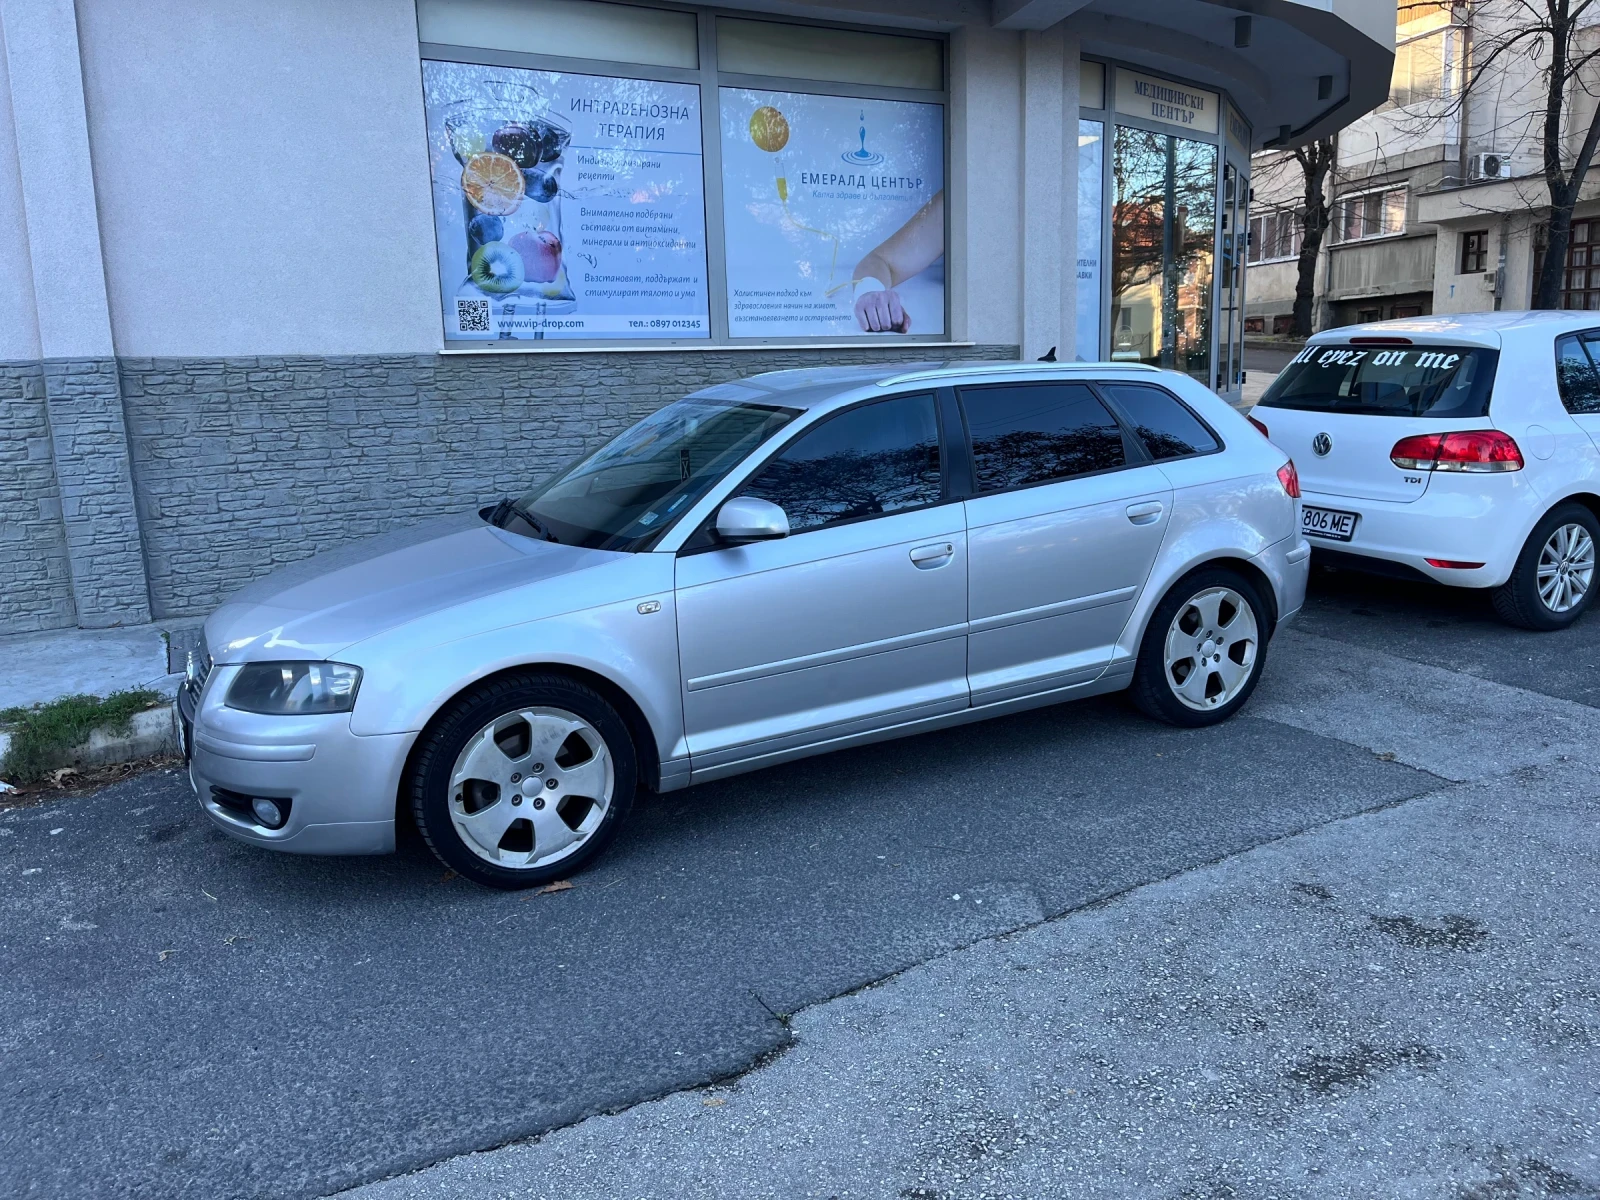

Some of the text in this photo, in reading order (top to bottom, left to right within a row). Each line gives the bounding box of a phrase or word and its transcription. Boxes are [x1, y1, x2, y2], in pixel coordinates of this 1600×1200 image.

[1134, 80, 1204, 110] МЕДИЦИНСКИ
[570, 97, 690, 120] ИНТРАВЕНОЗНА
[1151, 101, 1195, 124] ЦЕНТЪР
[599, 122, 665, 140] ТЕРАПИЯ
[577, 171, 615, 181] рецепти
[801, 172, 923, 190] ЕМЕРАЛД ЦЕНТЪР
[836, 190, 861, 200] здраве
[580, 207, 674, 220] Внимателно подбрани
[580, 223, 621, 233] съставки
[621, 225, 634, 233] от
[582, 238, 622, 248] минерали
[645, 273, 691, 285] поддържат
[584, 288, 641, 299] стимулират
[640, 289, 674, 298] тялото
[679, 290, 696, 300] ума
[776, 289, 799, 298] подход
[497, 318, 584, 330] www.vip-drop.com
[629, 319, 701, 329] тел.: 0897 012345
[1317, 349, 1369, 368] eyez
[1372, 350, 1409, 367] on
[1414, 351, 1460, 370] me
[1403, 476, 1422, 484] TDI
[1302, 510, 1352, 533] 806 ME
